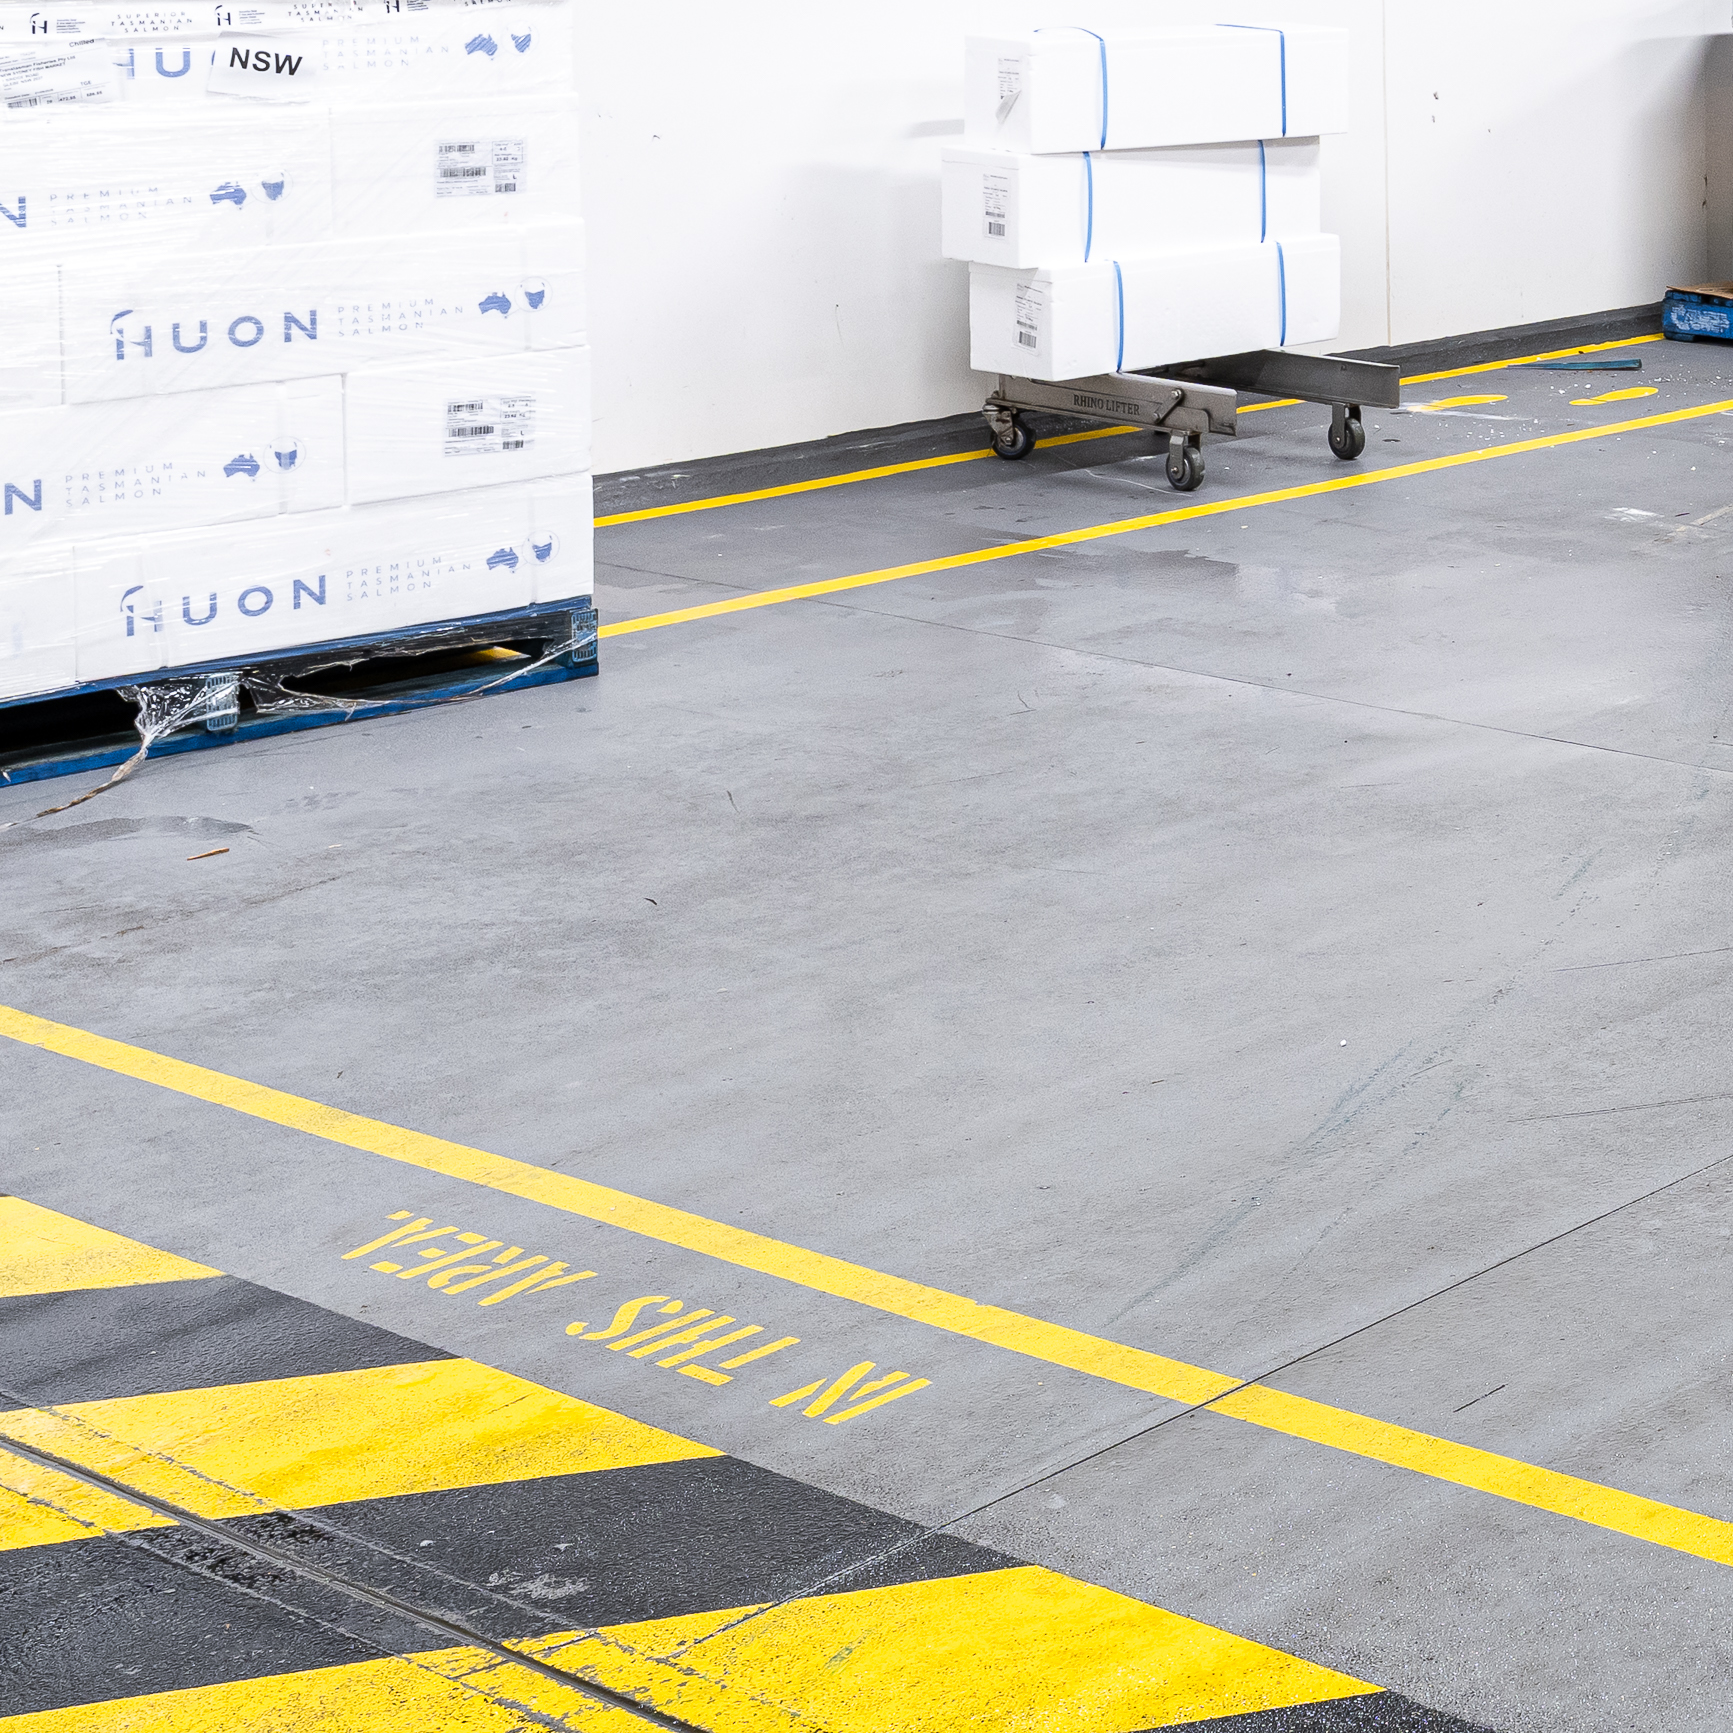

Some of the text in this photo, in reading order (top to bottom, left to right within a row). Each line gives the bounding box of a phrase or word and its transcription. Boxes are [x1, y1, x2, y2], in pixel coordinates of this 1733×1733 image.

[111, 18, 193, 26] TASMANIAN
[124, 25, 180, 33] SALMON
[229, 47, 303, 76] NSW
[338, 298, 434, 314] PREMIUM
[338, 306, 463, 325] TASMANIAN
[110, 309, 317, 360] HUON
[338, 321, 424, 337] SALMON
[1073, 394, 1140, 415] RHINO LIFTER
[65, 463, 173, 483] PREMIUM
[65, 470, 206, 495] TASMANIAN
[66, 488, 161, 507] SALMON
[347, 556, 442, 578] PREMIUM
[347, 563, 471, 589] TASMANIAN
[347, 580, 432, 602] SALMON
[120, 575, 326, 637] HUON
[564, 1295, 799, 1387] THIS
[769, 1360, 933, 1425] IN
